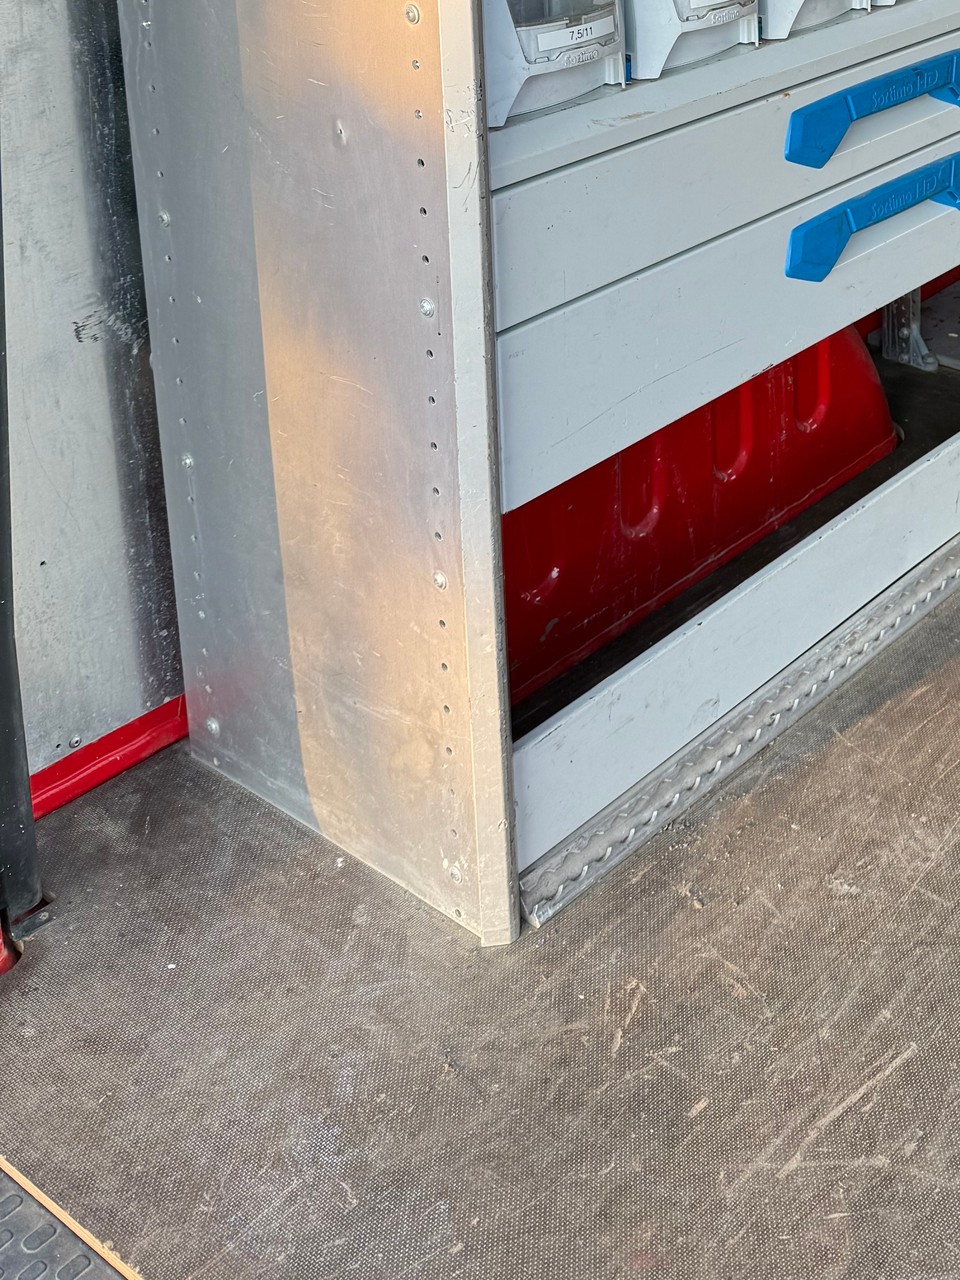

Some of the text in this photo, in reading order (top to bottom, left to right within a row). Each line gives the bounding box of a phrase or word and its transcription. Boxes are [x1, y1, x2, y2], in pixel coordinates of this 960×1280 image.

[569, 26, 593, 41] 7,5/11
[563, 50, 599, 66] Sortimo
[872, 83, 913, 108] Sortimo
[871, 191, 913, 219] Sortimo
